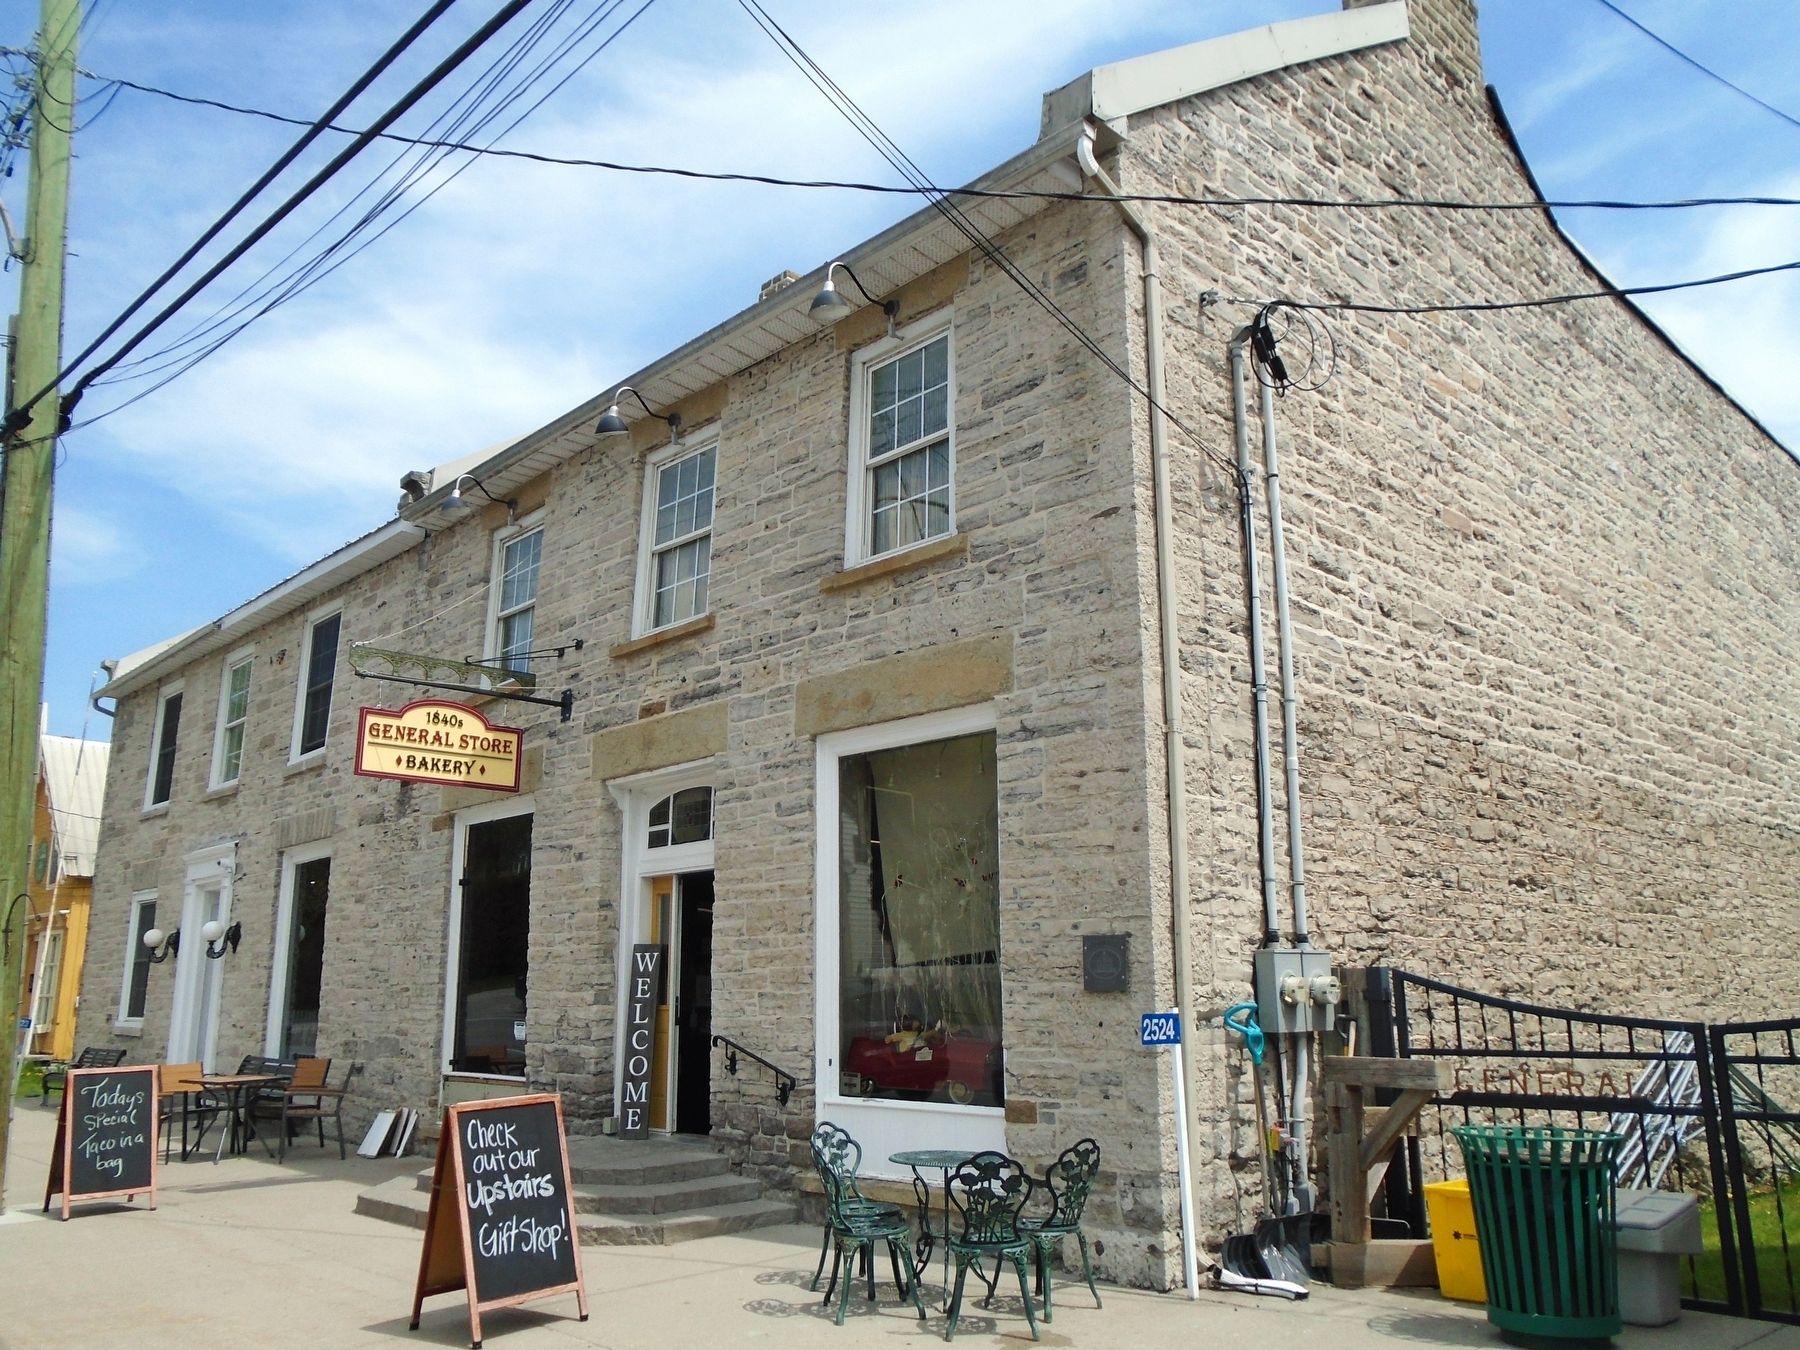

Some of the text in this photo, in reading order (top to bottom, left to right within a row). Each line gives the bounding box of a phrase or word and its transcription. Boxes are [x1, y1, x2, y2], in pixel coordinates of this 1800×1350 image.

[426, 711, 464, 728] 1840s
[368, 722, 514, 755] GENERAL STORE
[406, 755, 476, 775] BAKERY
[623, 952, 660, 1130] WELCOME
[1143, 1018, 1175, 1040] 2524
[80, 1077, 145, 1112] Todays
[78, 1131, 145, 1158] Taco in a
[467, 1118, 518, 1149] Check
[96, 1155, 123, 1178] bag
[473, 1148, 540, 1174] out our
[467, 1172, 555, 1216] Upstairs
[478, 1208, 569, 1261] Gift Shop!
